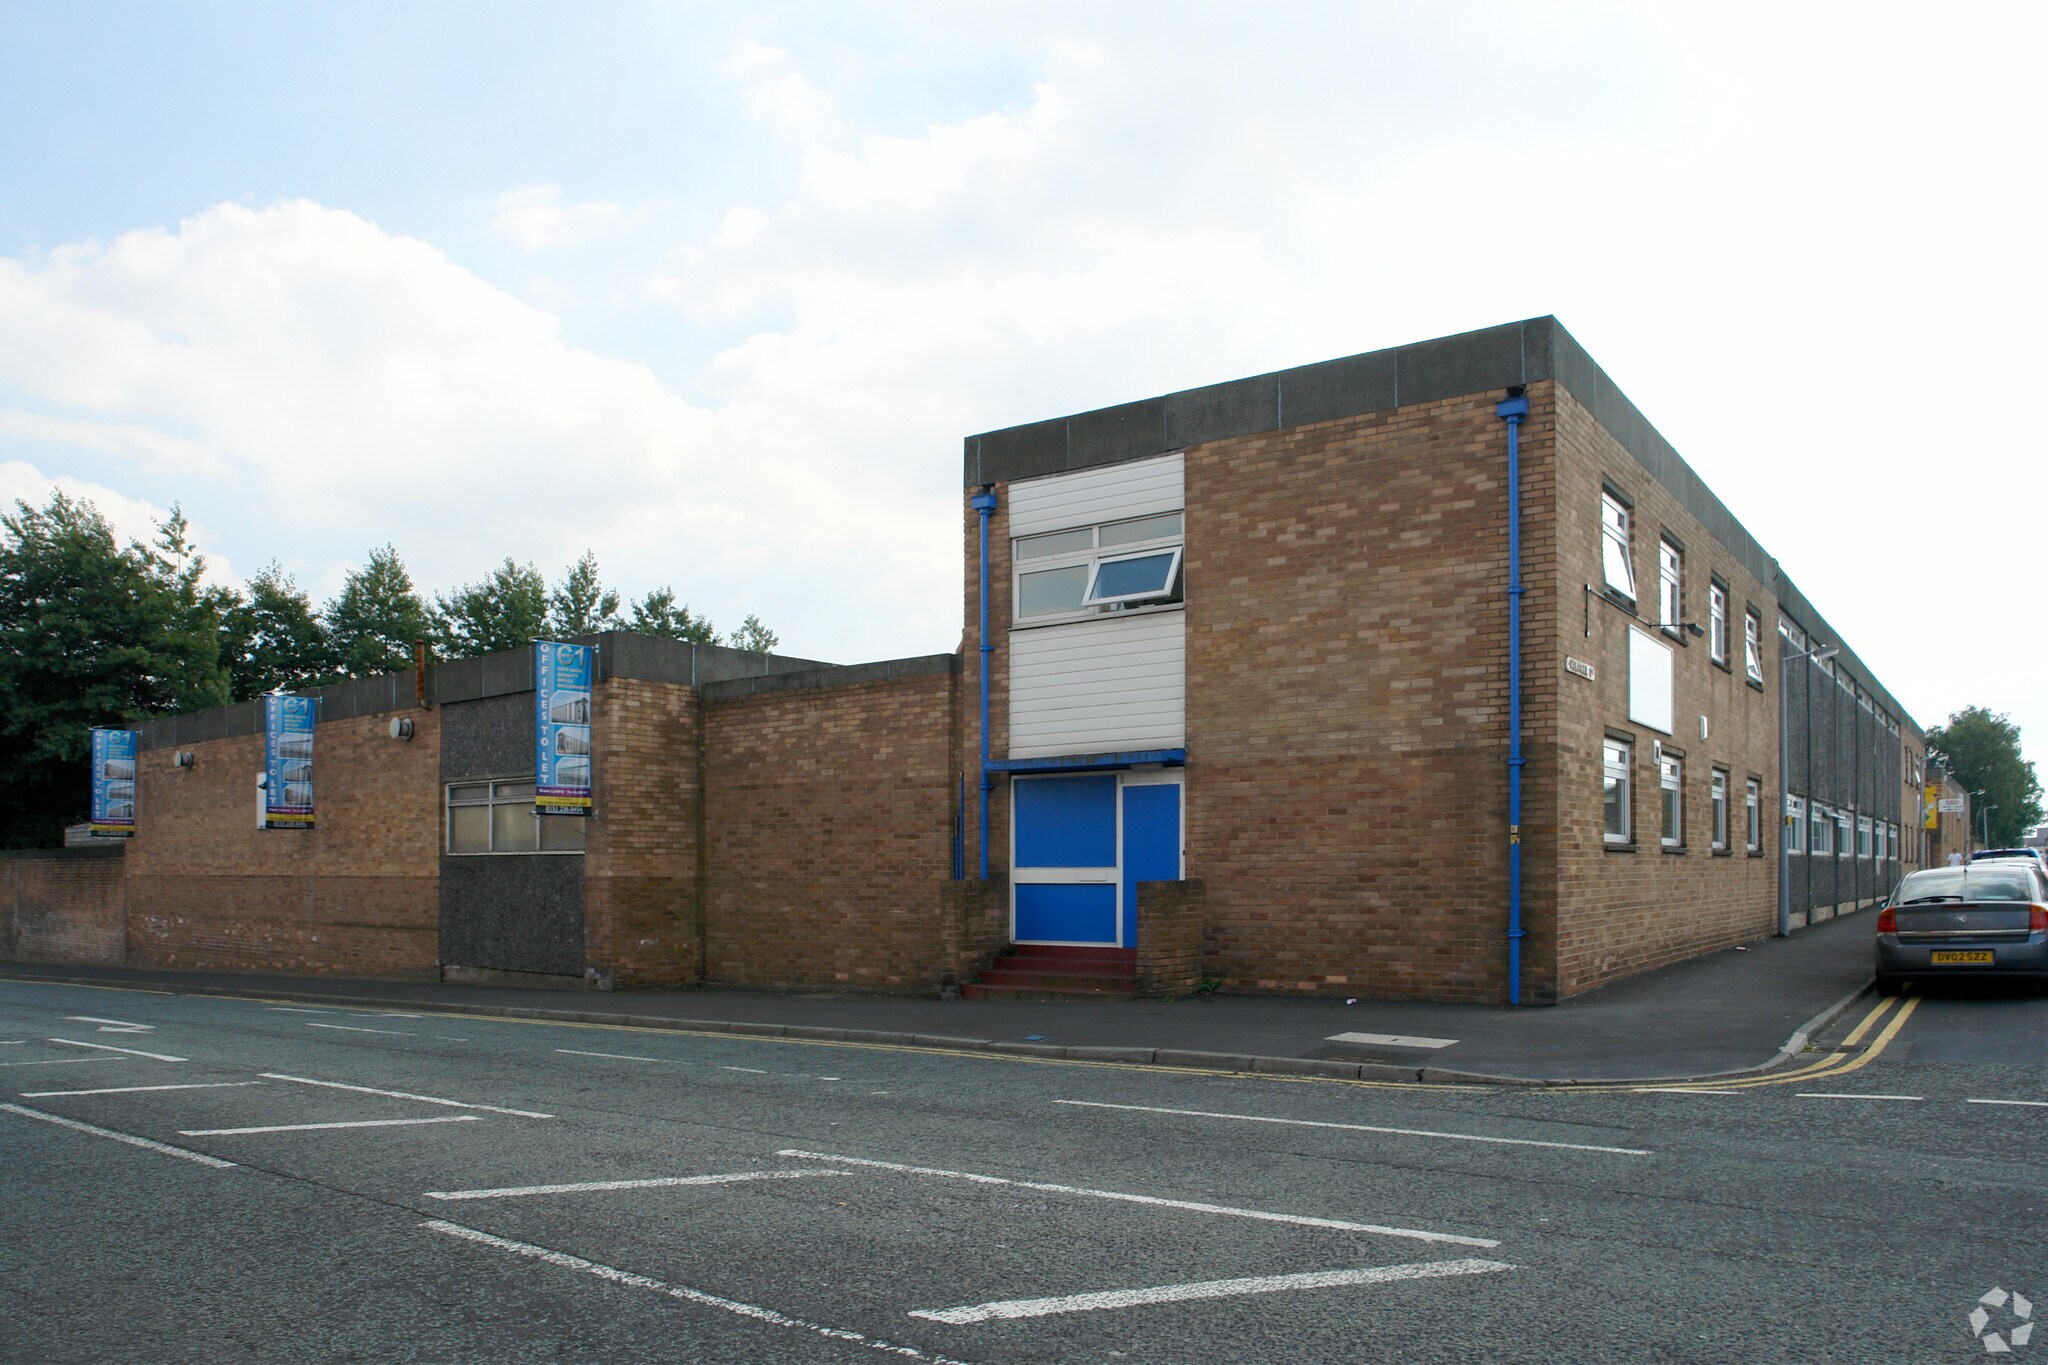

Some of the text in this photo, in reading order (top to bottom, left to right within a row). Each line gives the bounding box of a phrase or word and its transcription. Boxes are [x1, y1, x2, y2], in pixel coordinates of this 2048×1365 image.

[557, 645, 584, 667] C1
[540, 644, 549, 784] OFFICES TO LET
[95, 731, 103, 778] OFFICES
[268, 697, 278, 805] OFFICES TO LET
[95, 781, 102, 794] TO
[1937, 952, 1988, 961] DV02 SZZ
